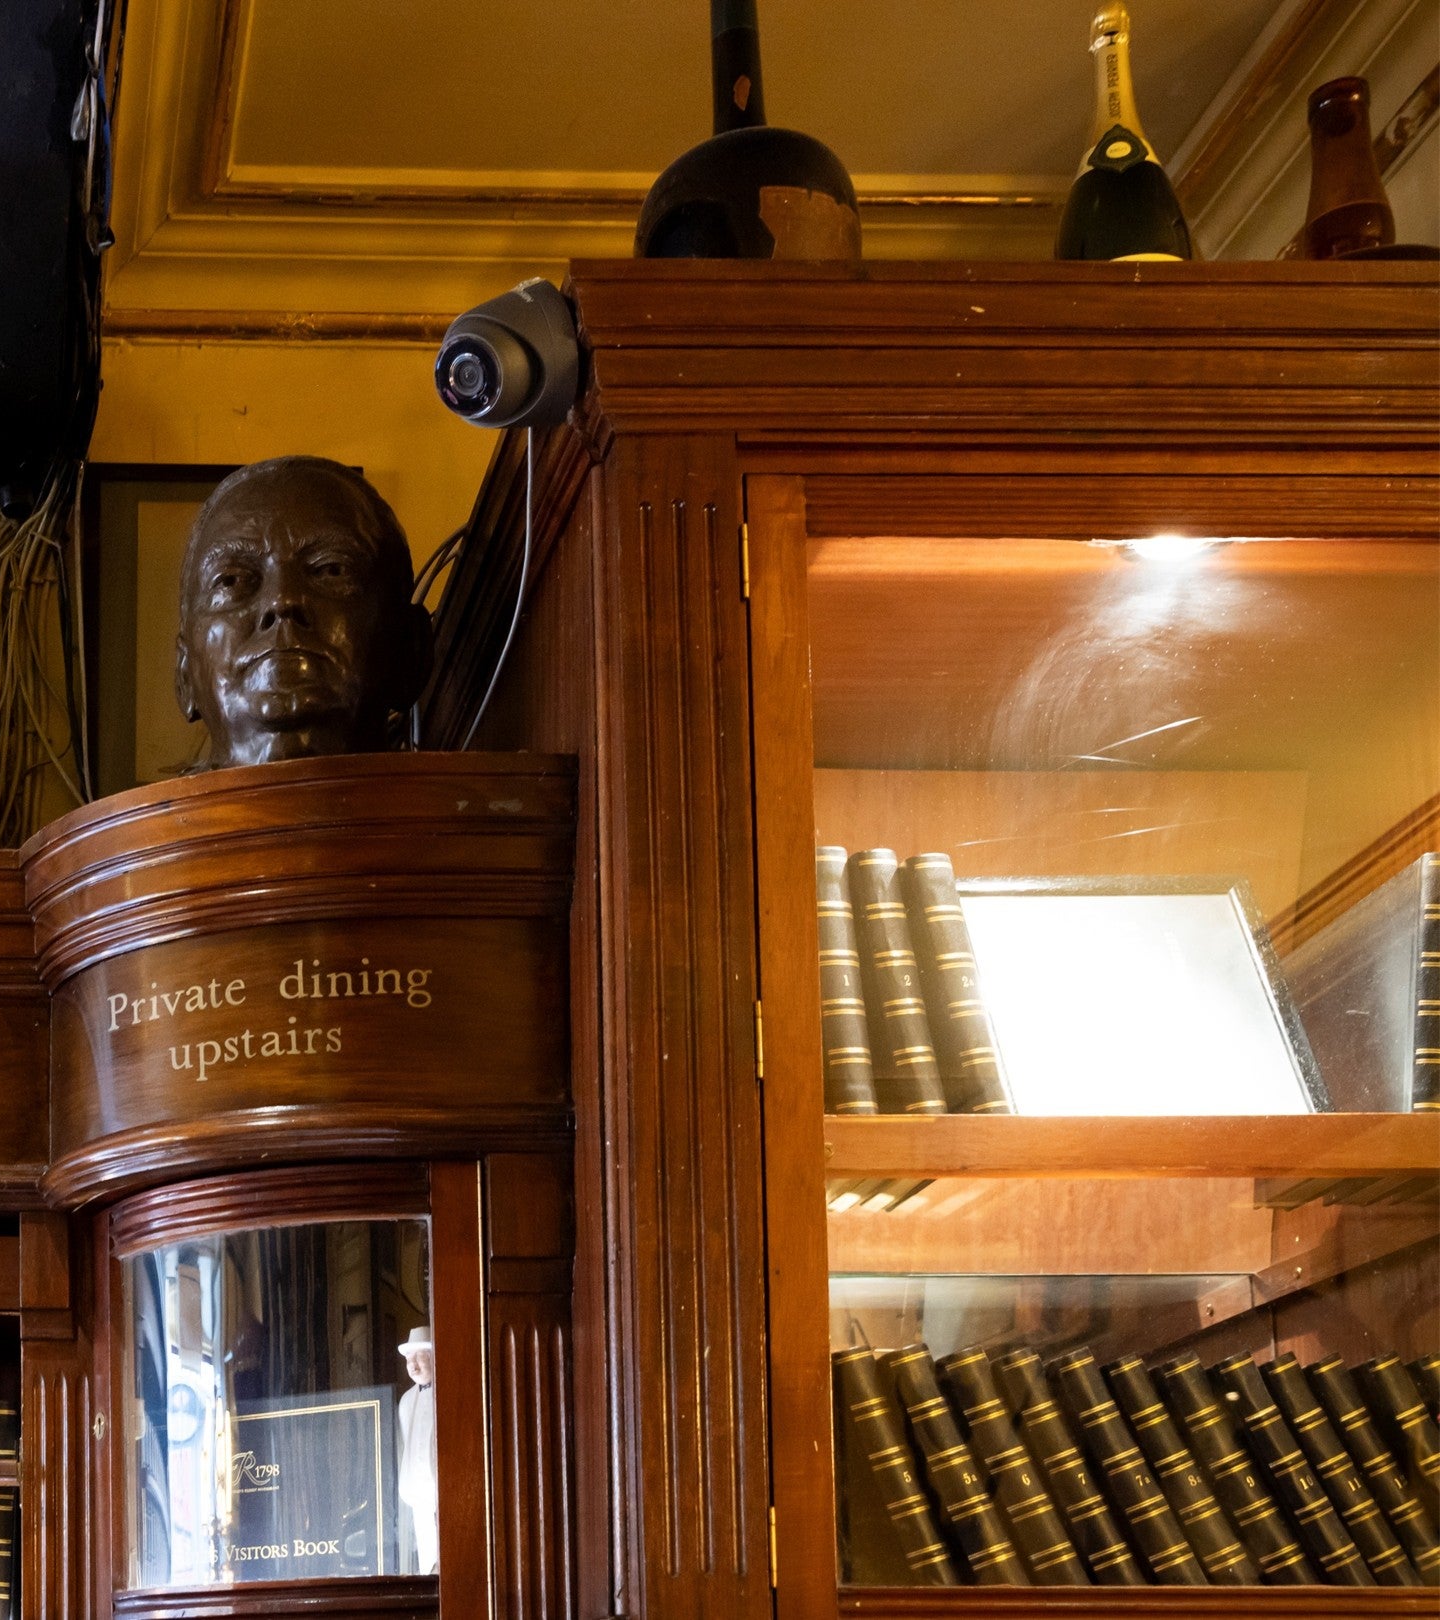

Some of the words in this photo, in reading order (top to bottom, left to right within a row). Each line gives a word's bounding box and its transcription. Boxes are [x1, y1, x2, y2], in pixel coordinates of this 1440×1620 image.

[903, 974, 912, 987] 2
[106, 978, 247, 1032] Private
[279, 957, 433, 1008] dining
[169, 1015, 343, 1082] upstairs
[254, 1463, 280, 1479] 1798
[902, 1470, 912, 1483] 5
[1021, 1473, 1031, 1486] 6
[1077, 1472, 1087, 1485] 7
[1245, 1475, 1256, 1488] 9
